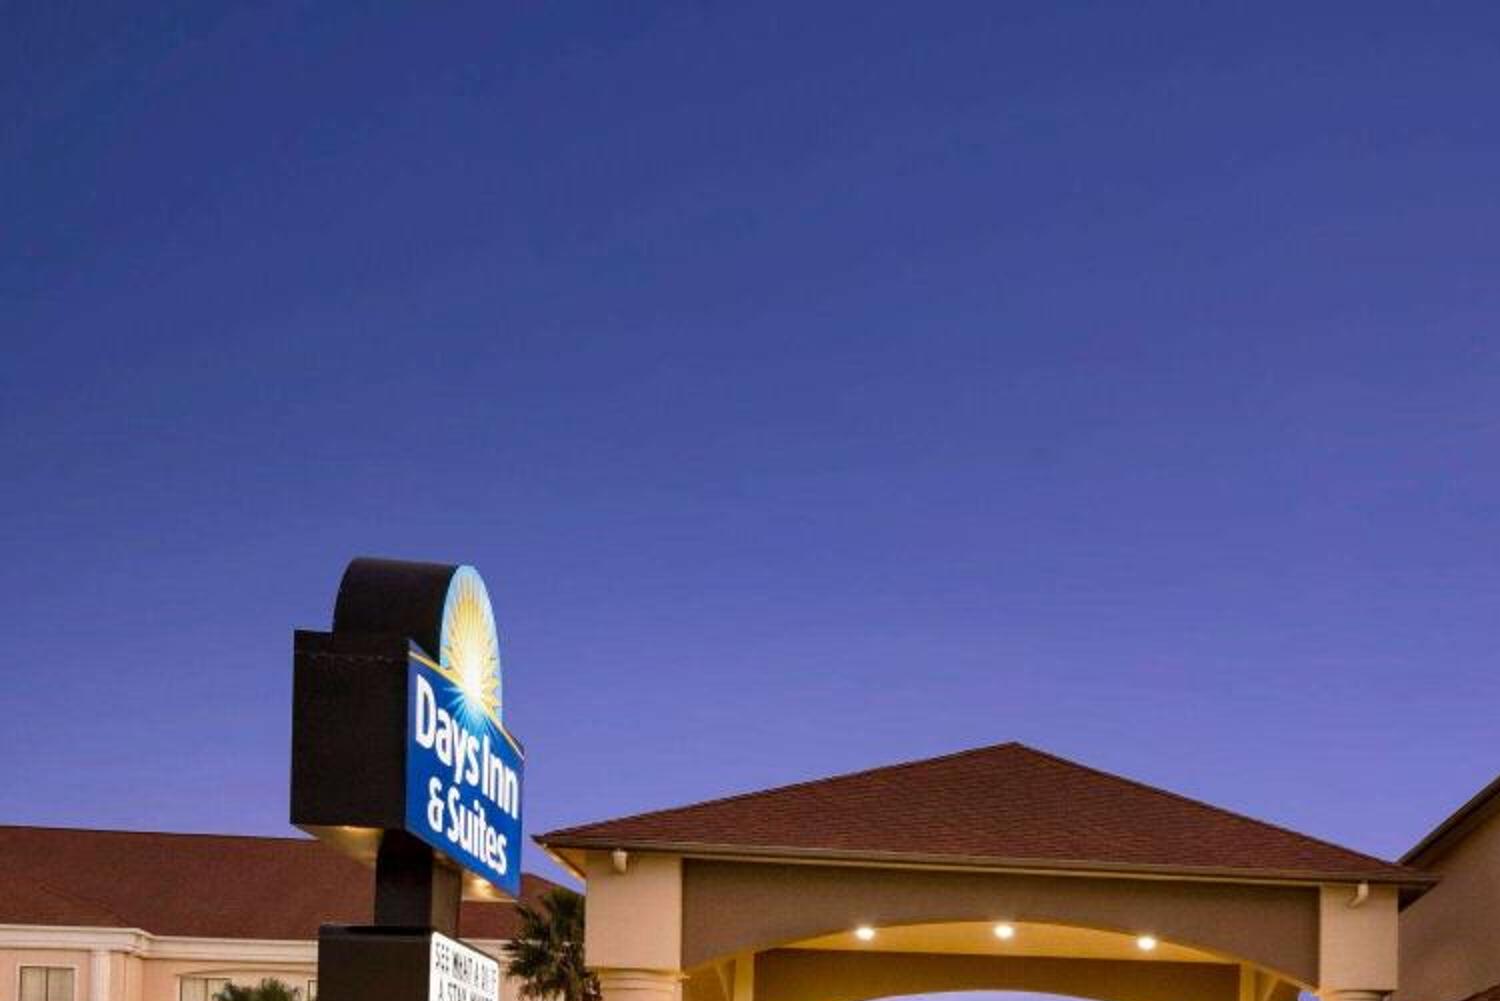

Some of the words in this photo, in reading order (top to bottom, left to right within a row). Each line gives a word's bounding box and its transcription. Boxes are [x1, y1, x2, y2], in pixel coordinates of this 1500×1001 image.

[416, 674, 480, 787] Days
[482, 734, 518, 820] Inn
[426, 776, 445, 833] &
[446, 786, 508, 876] Suites
[434, 941, 450, 972] SEE
[452, 949, 474, 984] WHAT
